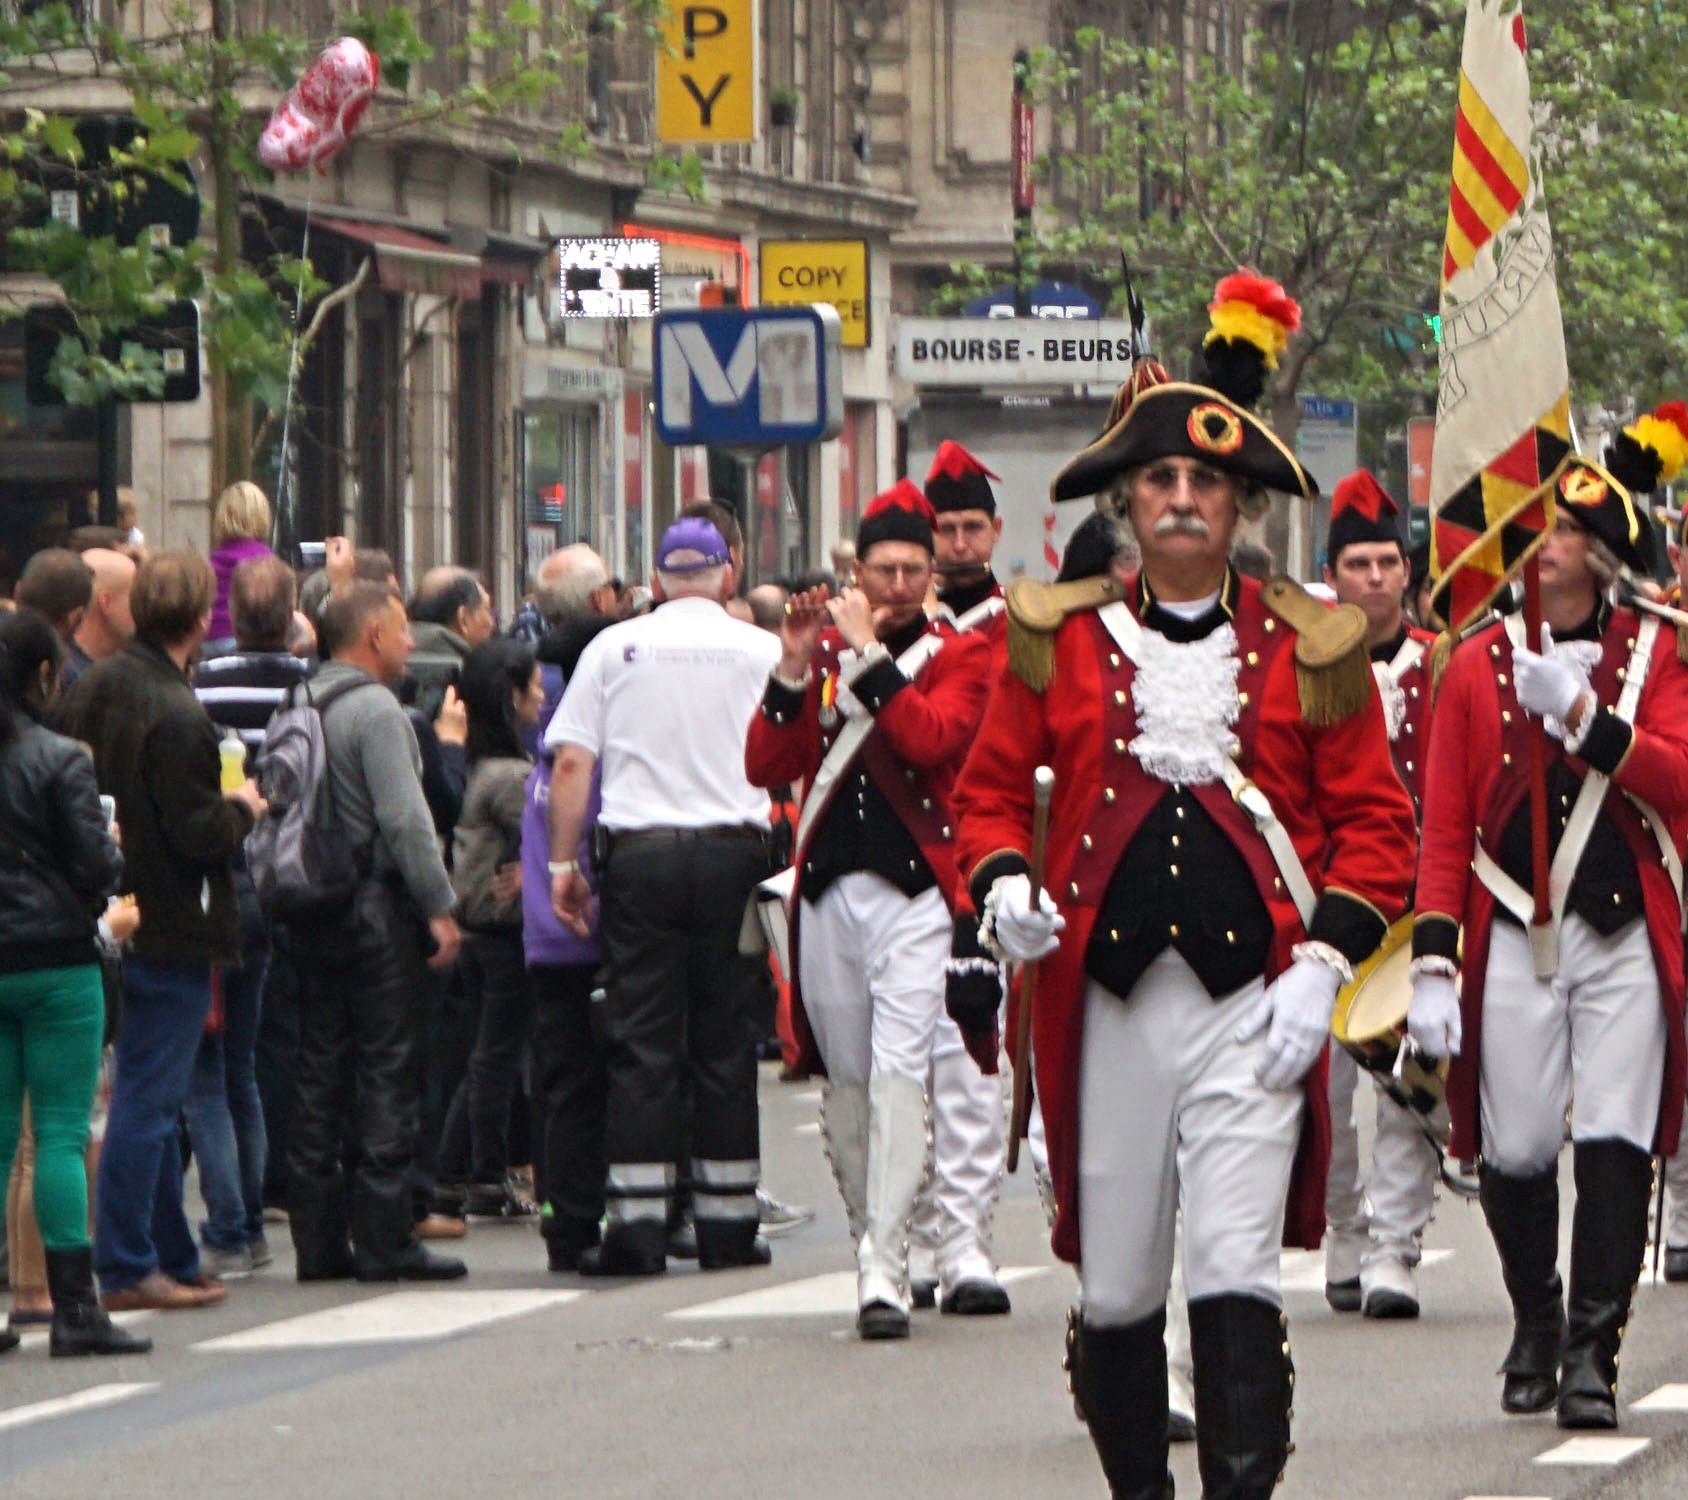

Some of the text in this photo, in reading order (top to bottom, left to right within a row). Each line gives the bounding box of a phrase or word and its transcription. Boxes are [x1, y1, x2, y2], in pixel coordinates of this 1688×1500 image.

[778, 266, 846, 288] COPY
[912, 339, 1020, 361] BOURSE
[1043, 339, 1131, 361] BEURS
